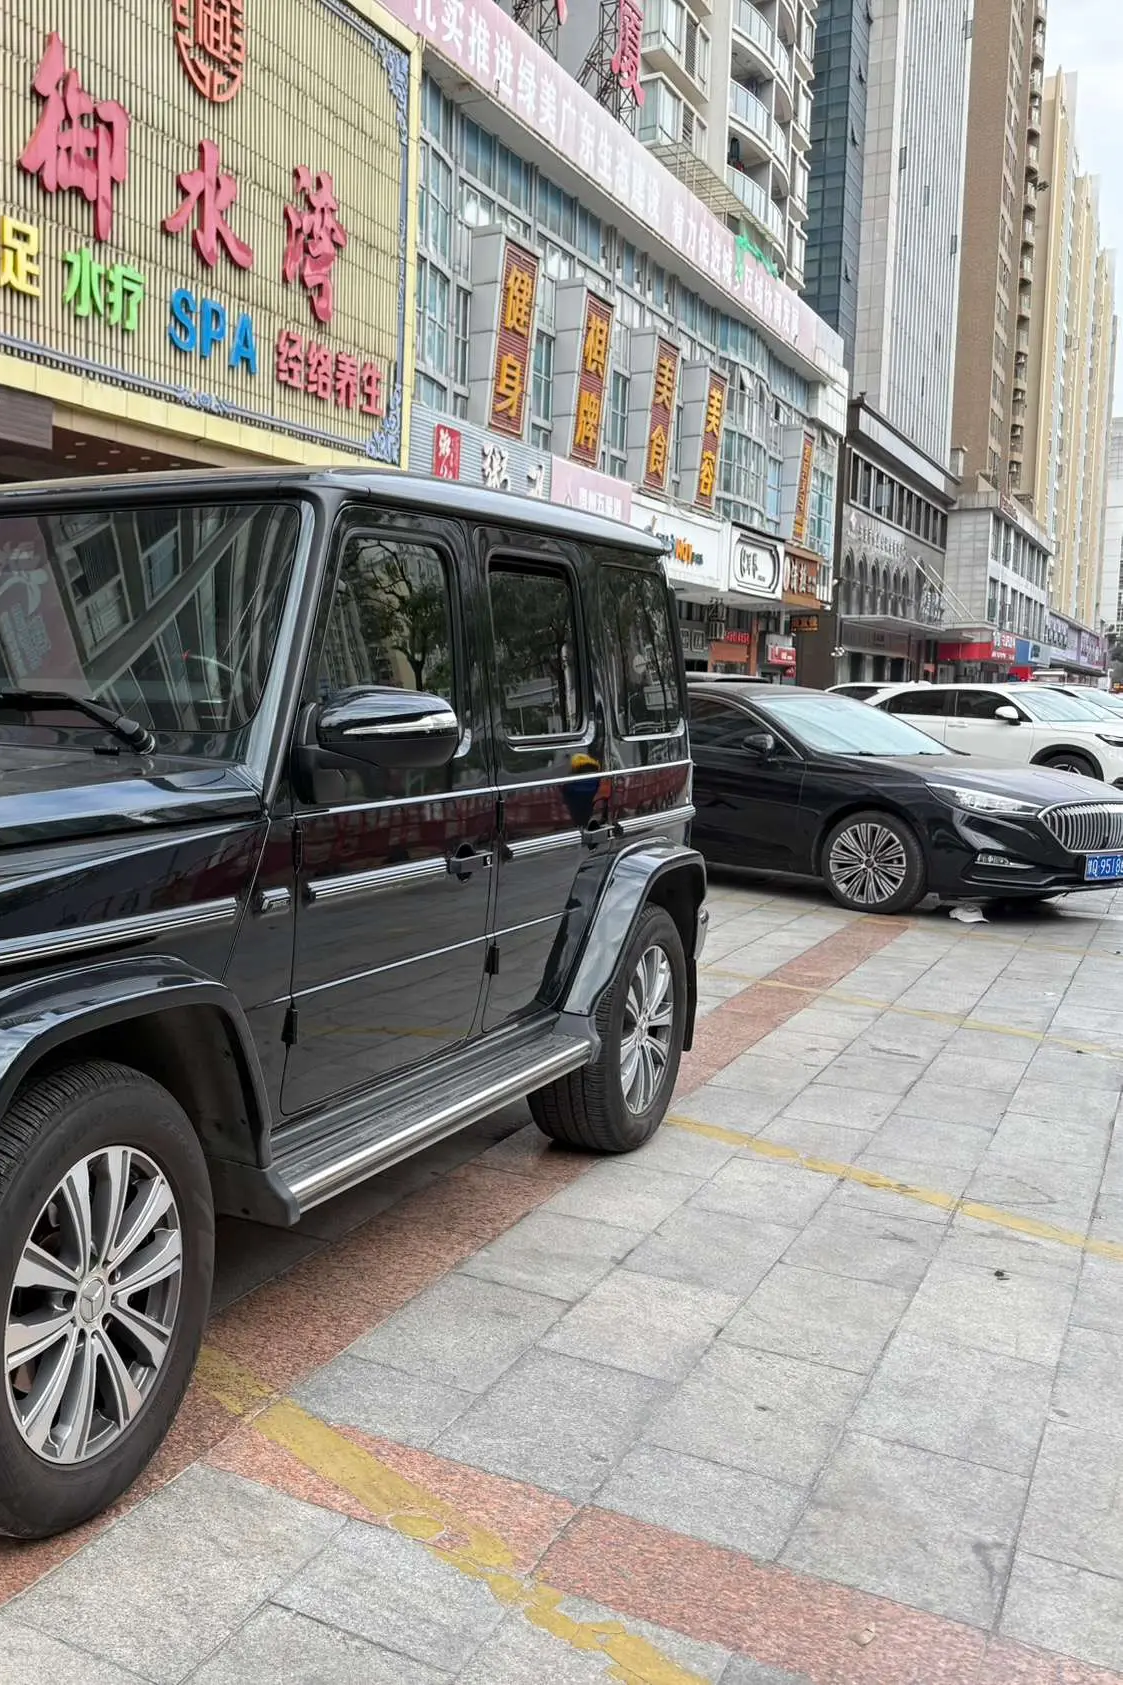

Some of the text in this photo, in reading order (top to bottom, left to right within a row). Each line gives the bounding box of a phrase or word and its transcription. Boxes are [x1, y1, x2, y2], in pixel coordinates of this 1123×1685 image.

[19, 31, 347, 323] 御水湾
[62, 247, 146, 332] 水疗
[168, 287, 259, 375] SPA
[276, 330, 385, 417] 经络养生
[493, 264, 533, 418] 健身
[576, 314, 609, 450] 棋牌
[649, 357, 677, 477] 美食
[699, 387, 722, 498] 美容
